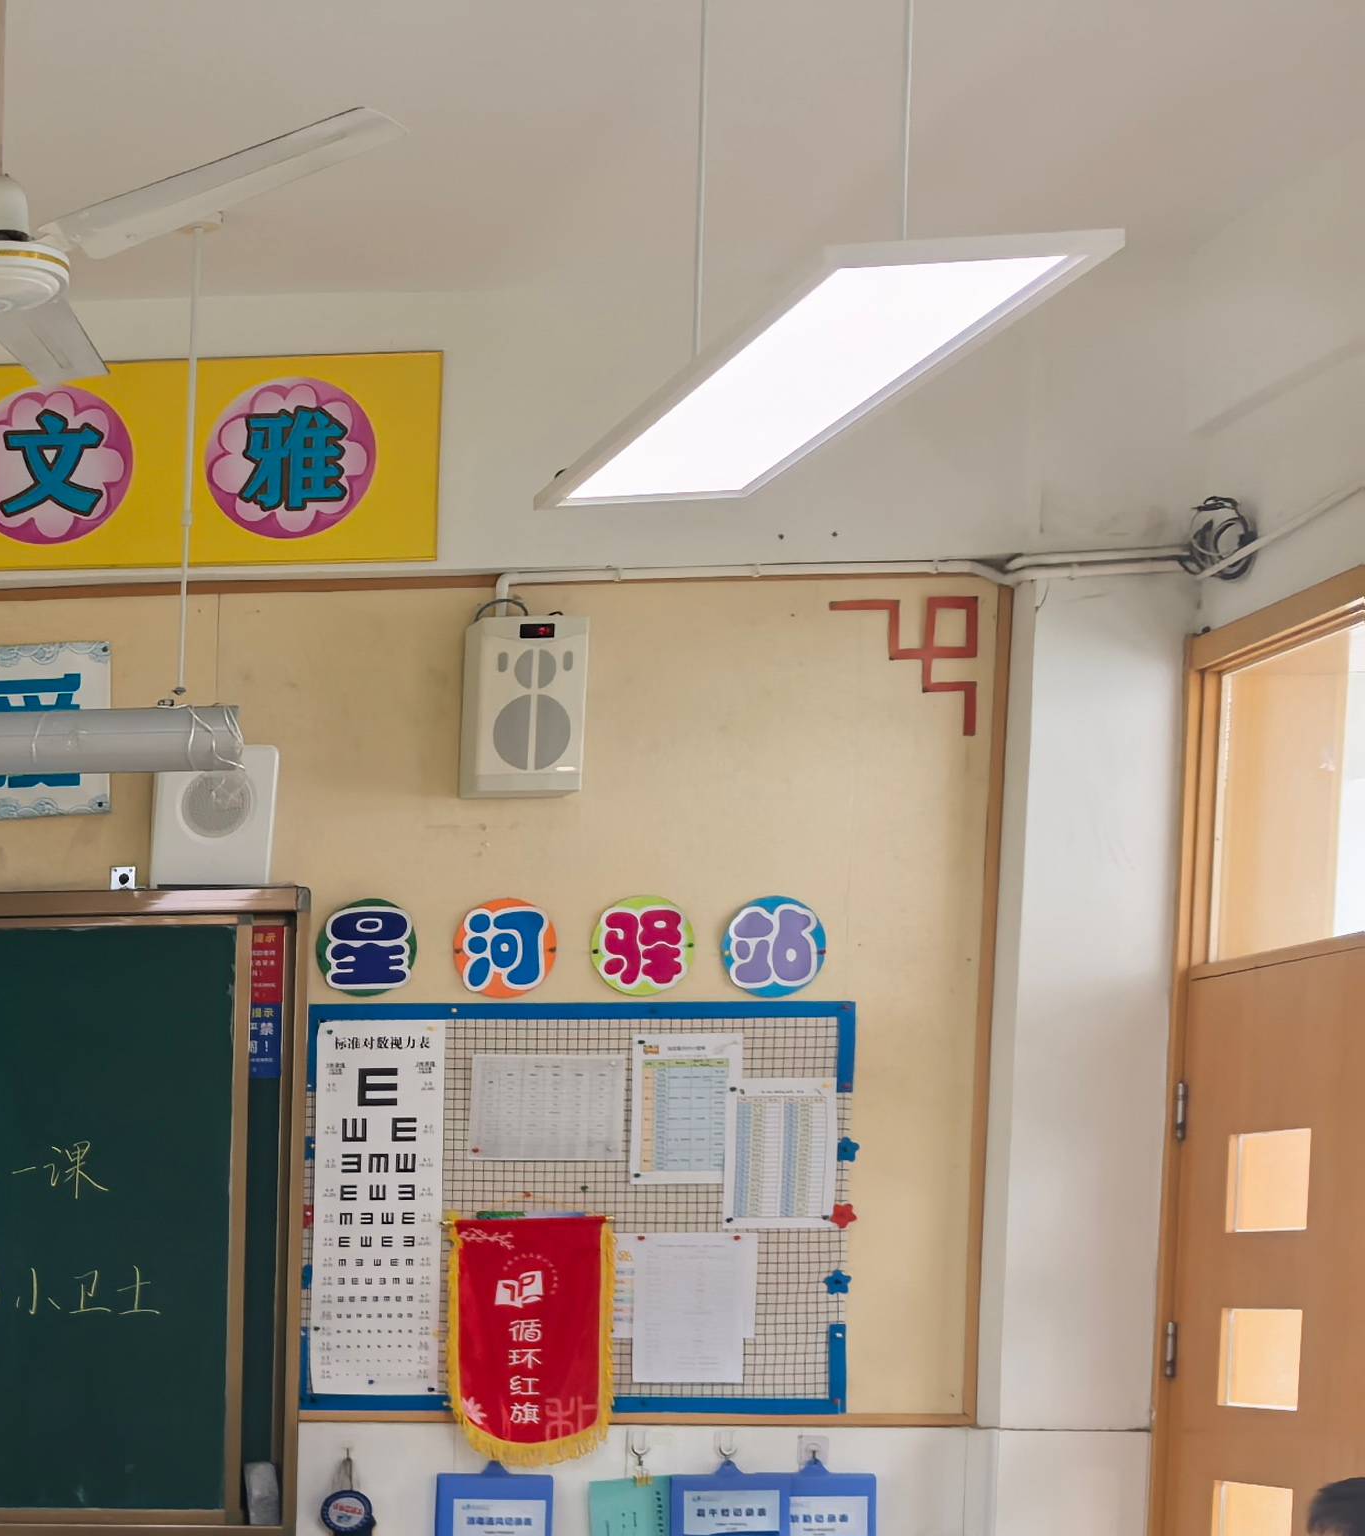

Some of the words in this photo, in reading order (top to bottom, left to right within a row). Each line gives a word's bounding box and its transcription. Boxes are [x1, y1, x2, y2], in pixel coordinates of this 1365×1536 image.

[327, 903, 819, 992] 星河驿站
[335, 1036, 431, 1050] 标准对数视力表
[508, 1318, 542, 1425] 循环红旗
